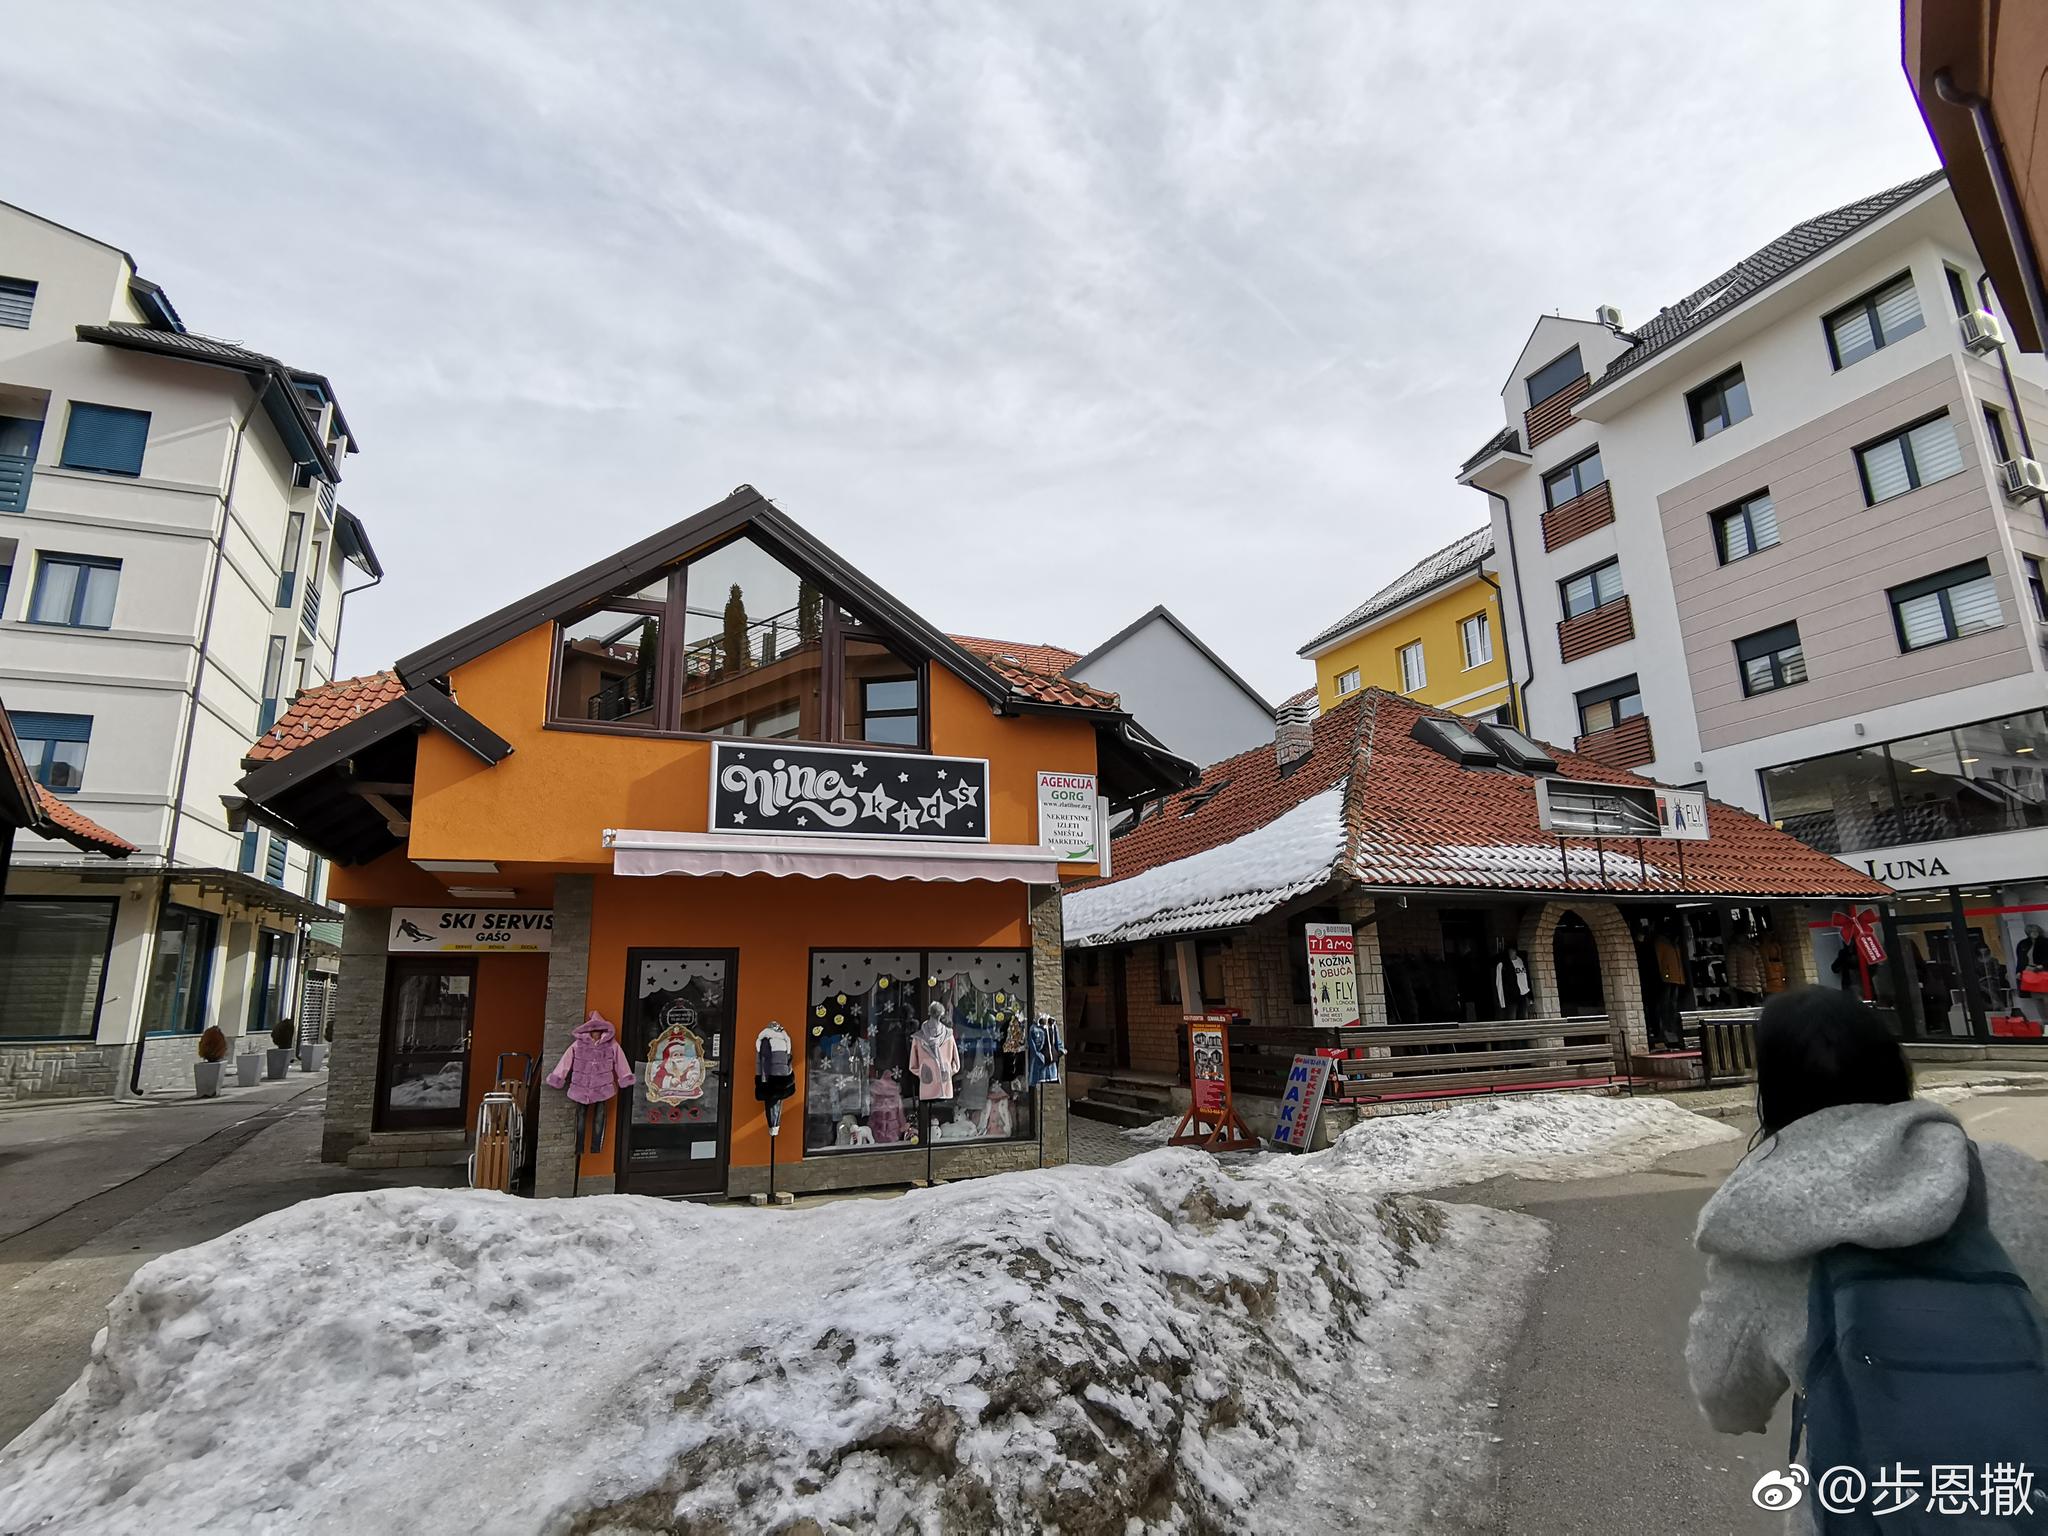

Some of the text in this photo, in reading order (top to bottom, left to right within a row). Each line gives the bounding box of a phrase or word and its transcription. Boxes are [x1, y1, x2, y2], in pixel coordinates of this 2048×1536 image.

[1040, 776, 1093, 790] AGENCIJA
[1051, 790, 1084, 801] GORG
[870, 785, 972, 826] kids
[1046, 813, 1090, 822] NEKRETNINE
[1685, 804, 1701, 822] FLY
[1053, 829, 1084, 838] SMEŠTAJ
[1048, 838, 1089, 846] MARKETING
[1864, 857, 1950, 882] LUNA
[439, 913, 553, 930] SKI SERVIS
[475, 930, 511, 942] GAŠO
[1319, 954, 1352, 967] KOŽNA
[1335, 982, 1354, 1000] FLY
